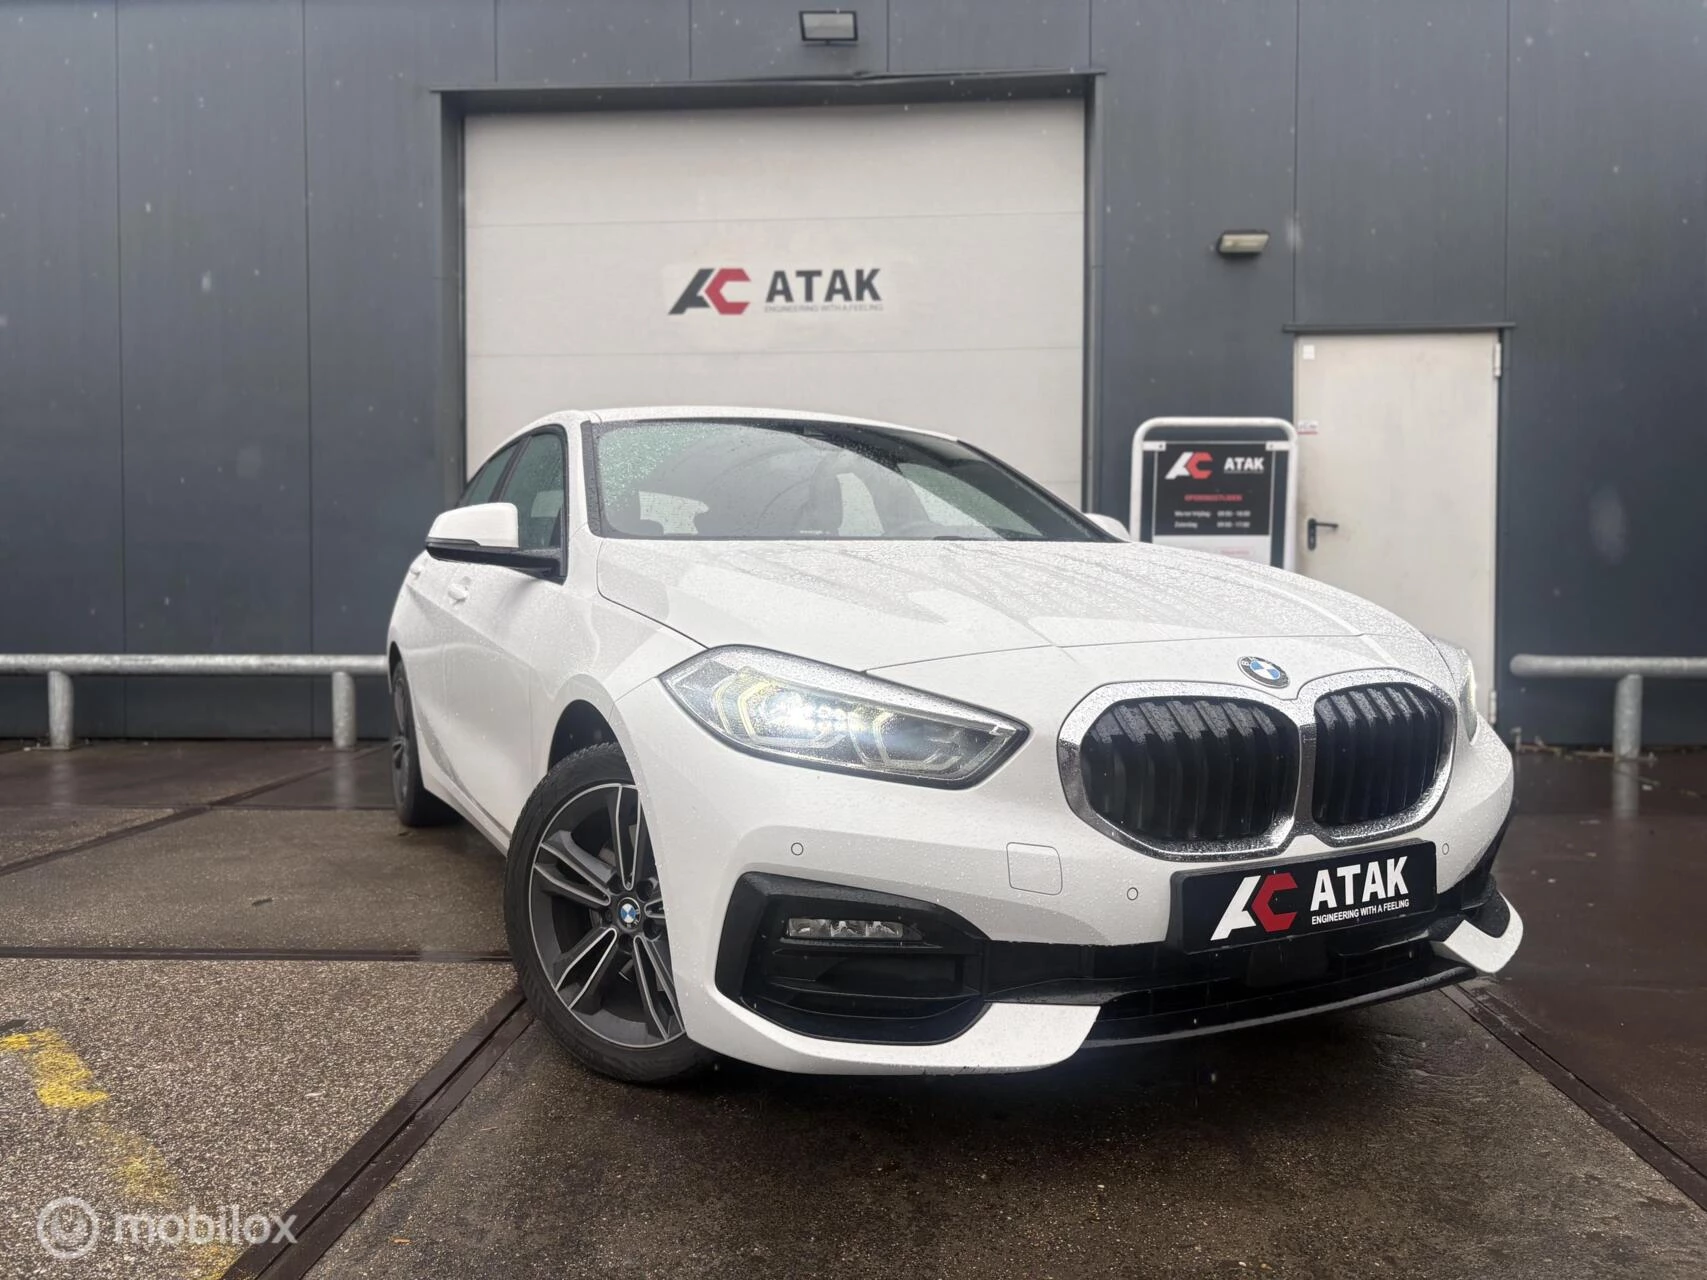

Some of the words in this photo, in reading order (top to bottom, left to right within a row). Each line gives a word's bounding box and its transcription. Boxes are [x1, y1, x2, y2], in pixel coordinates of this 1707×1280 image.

[765, 268, 883, 304] ATAK
[764, 305, 819, 313] ENGINEERING
[821, 304, 842, 312] WITH
[849, 303, 884, 312] FEELING
[1223, 457, 1264, 471] ATAK
[1310, 856, 1409, 911] ATAK
[1311, 908, 1360, 925] ENGINEERING
[1360, 905, 1377, 917] WITH
[1378, 904, 1383, 913] A
[1383, 899, 1409, 912] FEELING
